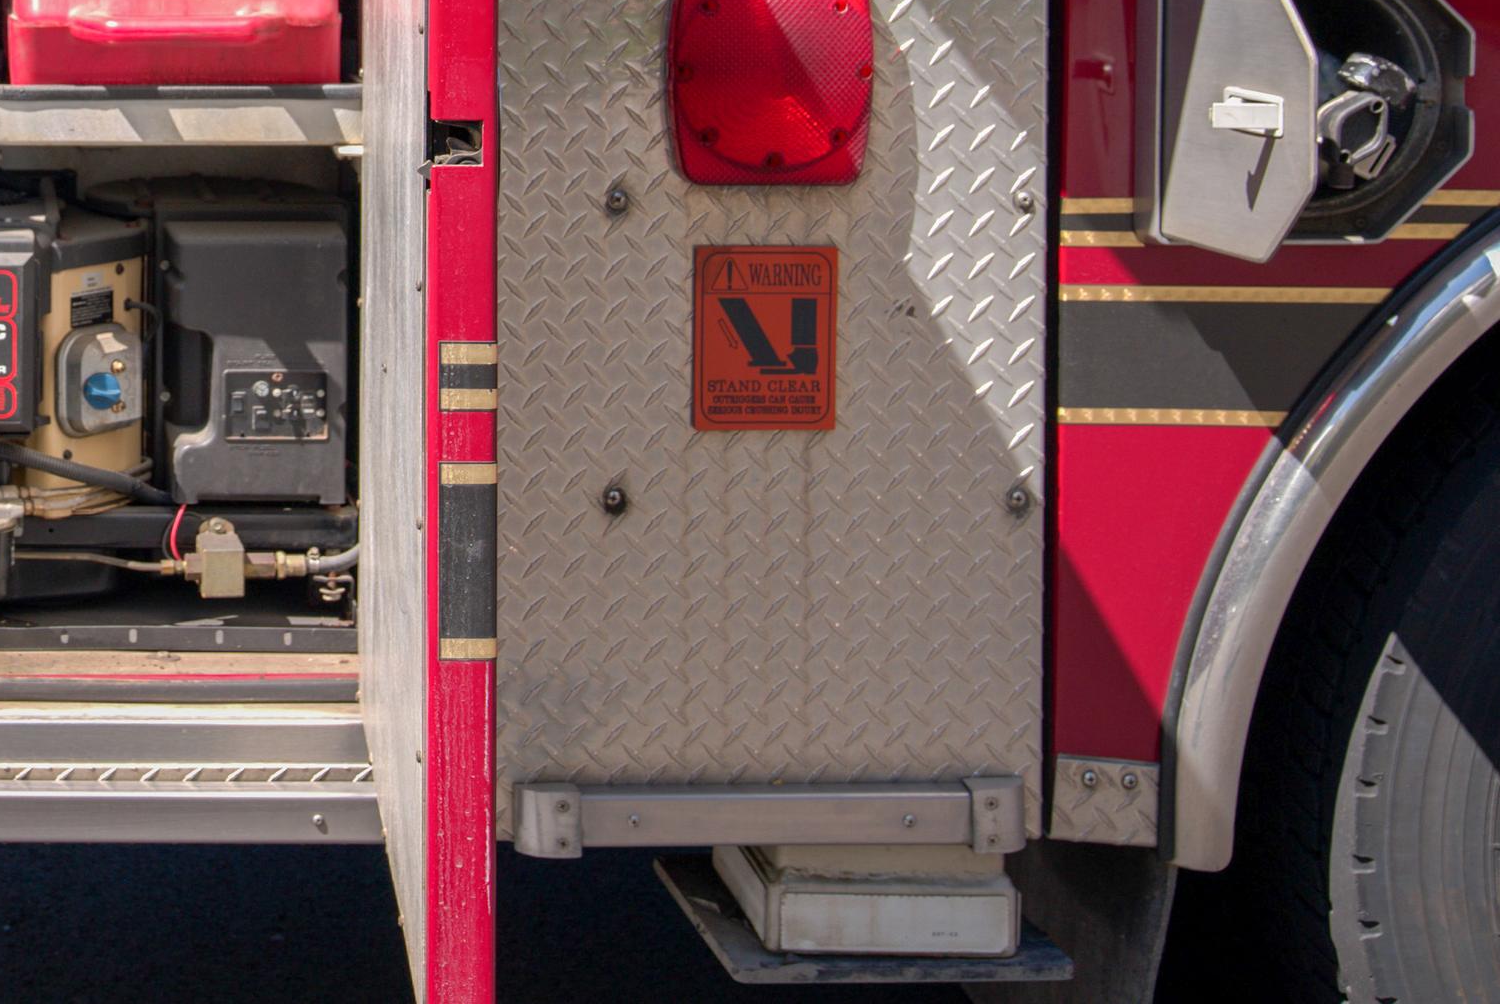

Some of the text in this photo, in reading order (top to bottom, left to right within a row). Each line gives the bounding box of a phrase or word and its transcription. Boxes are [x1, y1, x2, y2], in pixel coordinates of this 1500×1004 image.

[749, 264, 822, 287] WARNING
[707, 380, 822, 393] STAND CLEAR
[768, 395, 787, 404] CAN
[788, 395, 816, 404] CAUSE
